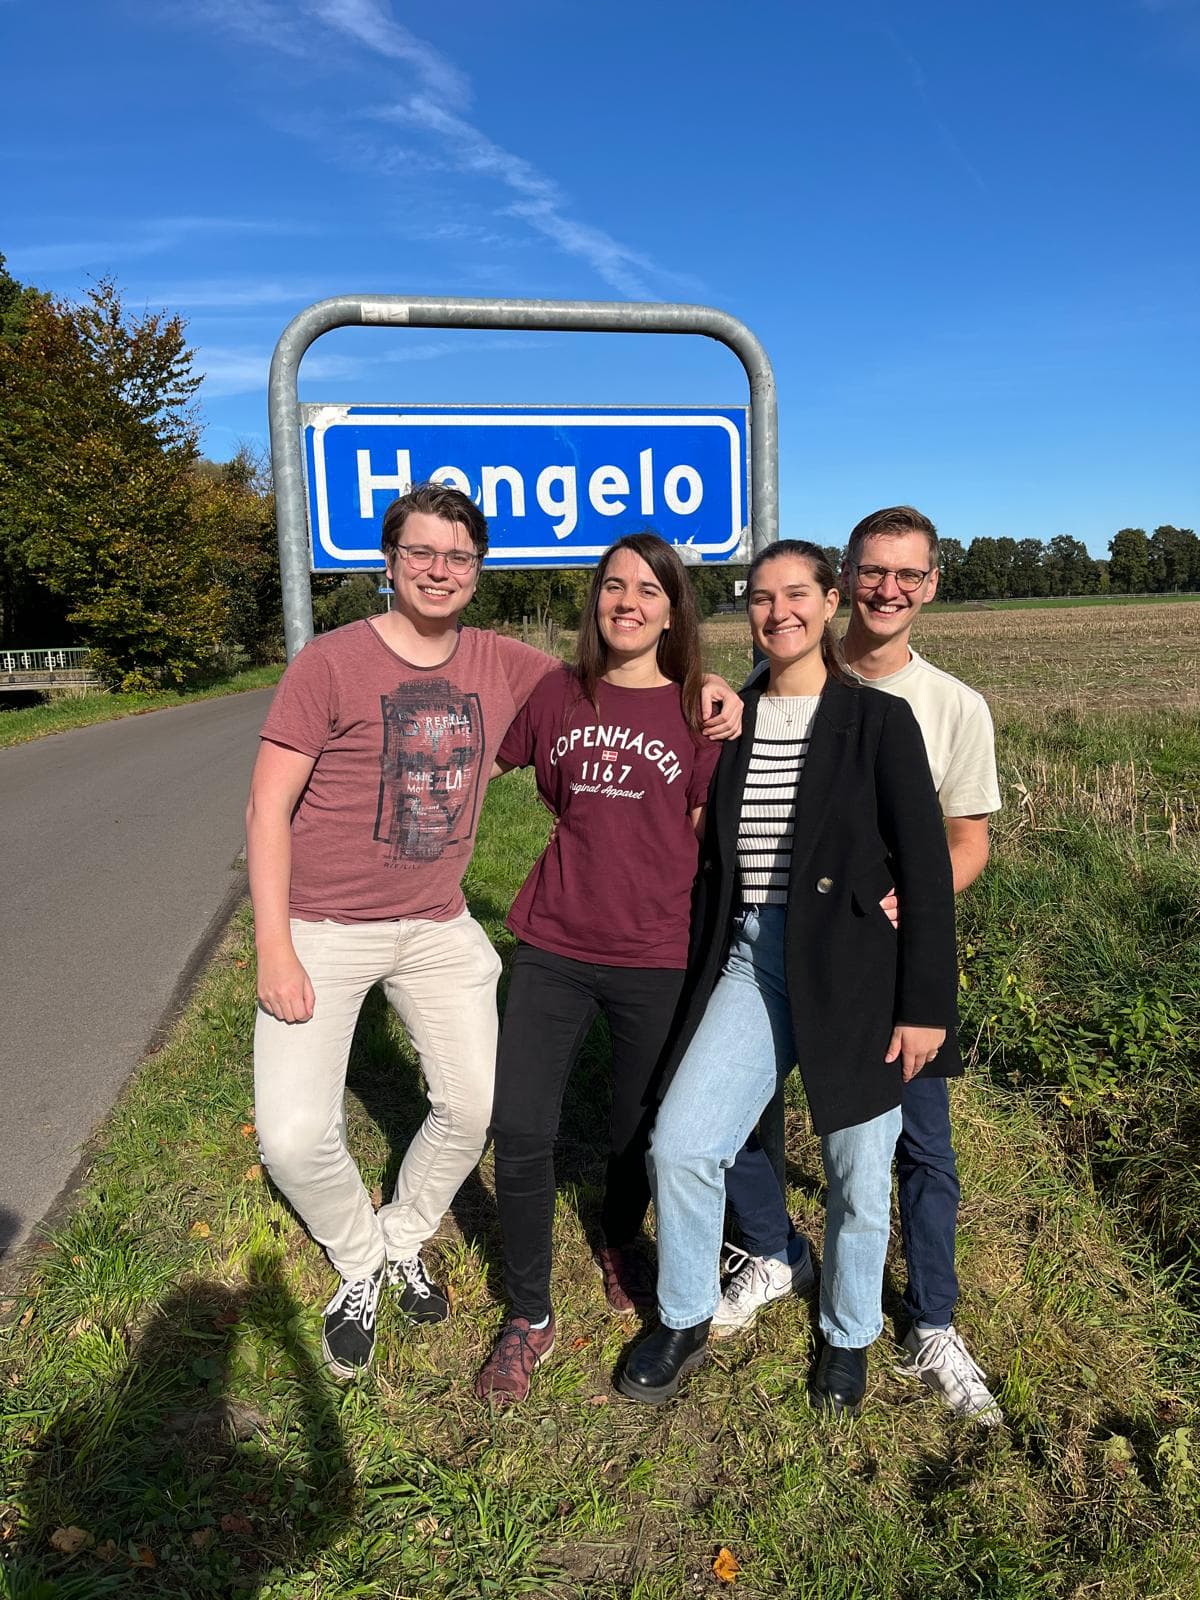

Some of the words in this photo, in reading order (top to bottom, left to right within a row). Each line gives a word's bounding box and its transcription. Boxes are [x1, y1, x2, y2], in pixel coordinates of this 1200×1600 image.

[549, 725, 683, 785] COPENHAGEN
[581, 761, 633, 784] 1167
[601, 785, 645, 800] Apparel
